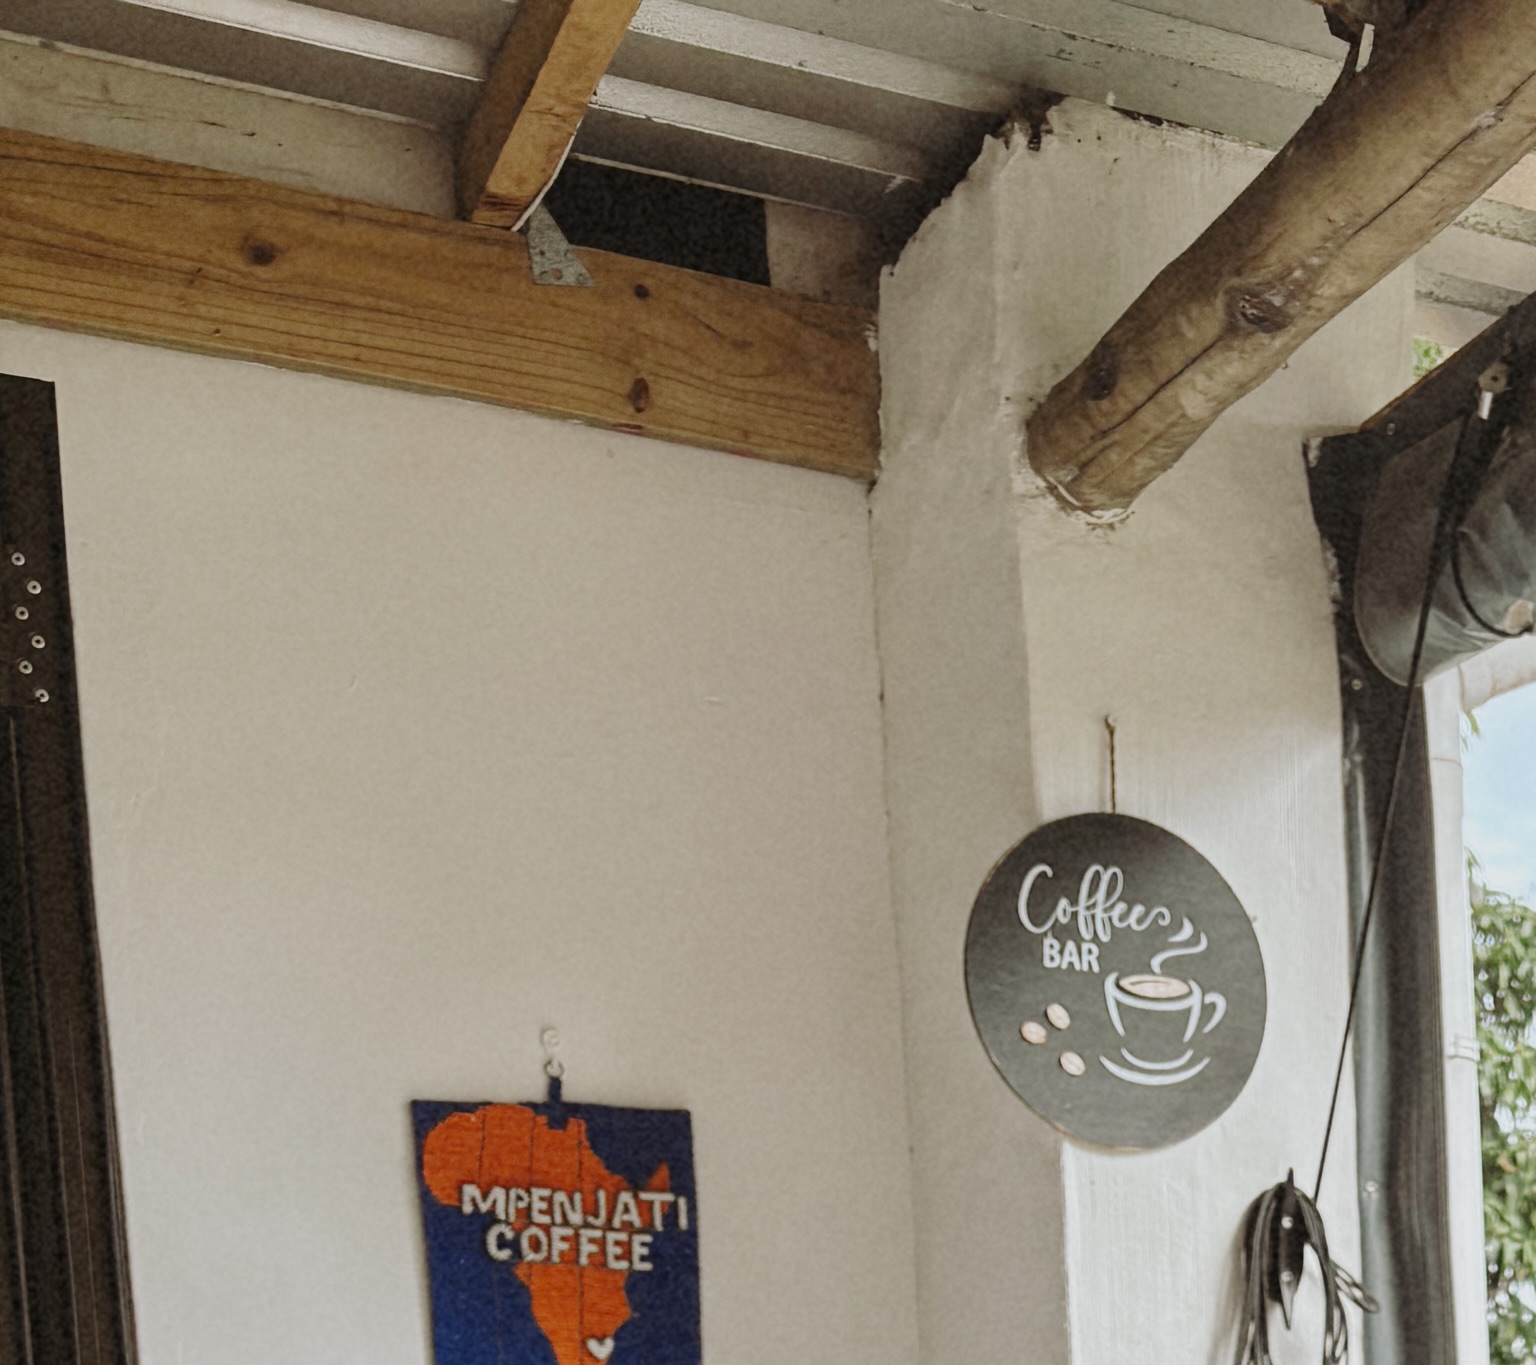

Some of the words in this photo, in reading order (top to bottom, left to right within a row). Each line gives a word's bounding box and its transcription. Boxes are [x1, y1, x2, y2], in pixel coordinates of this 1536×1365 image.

[1017, 864, 1171, 943] Coffee
[1042, 936, 1100, 973] BAR
[461, 1184, 689, 1232] MPENJATI
[486, 1222, 654, 1271] COFFEE
